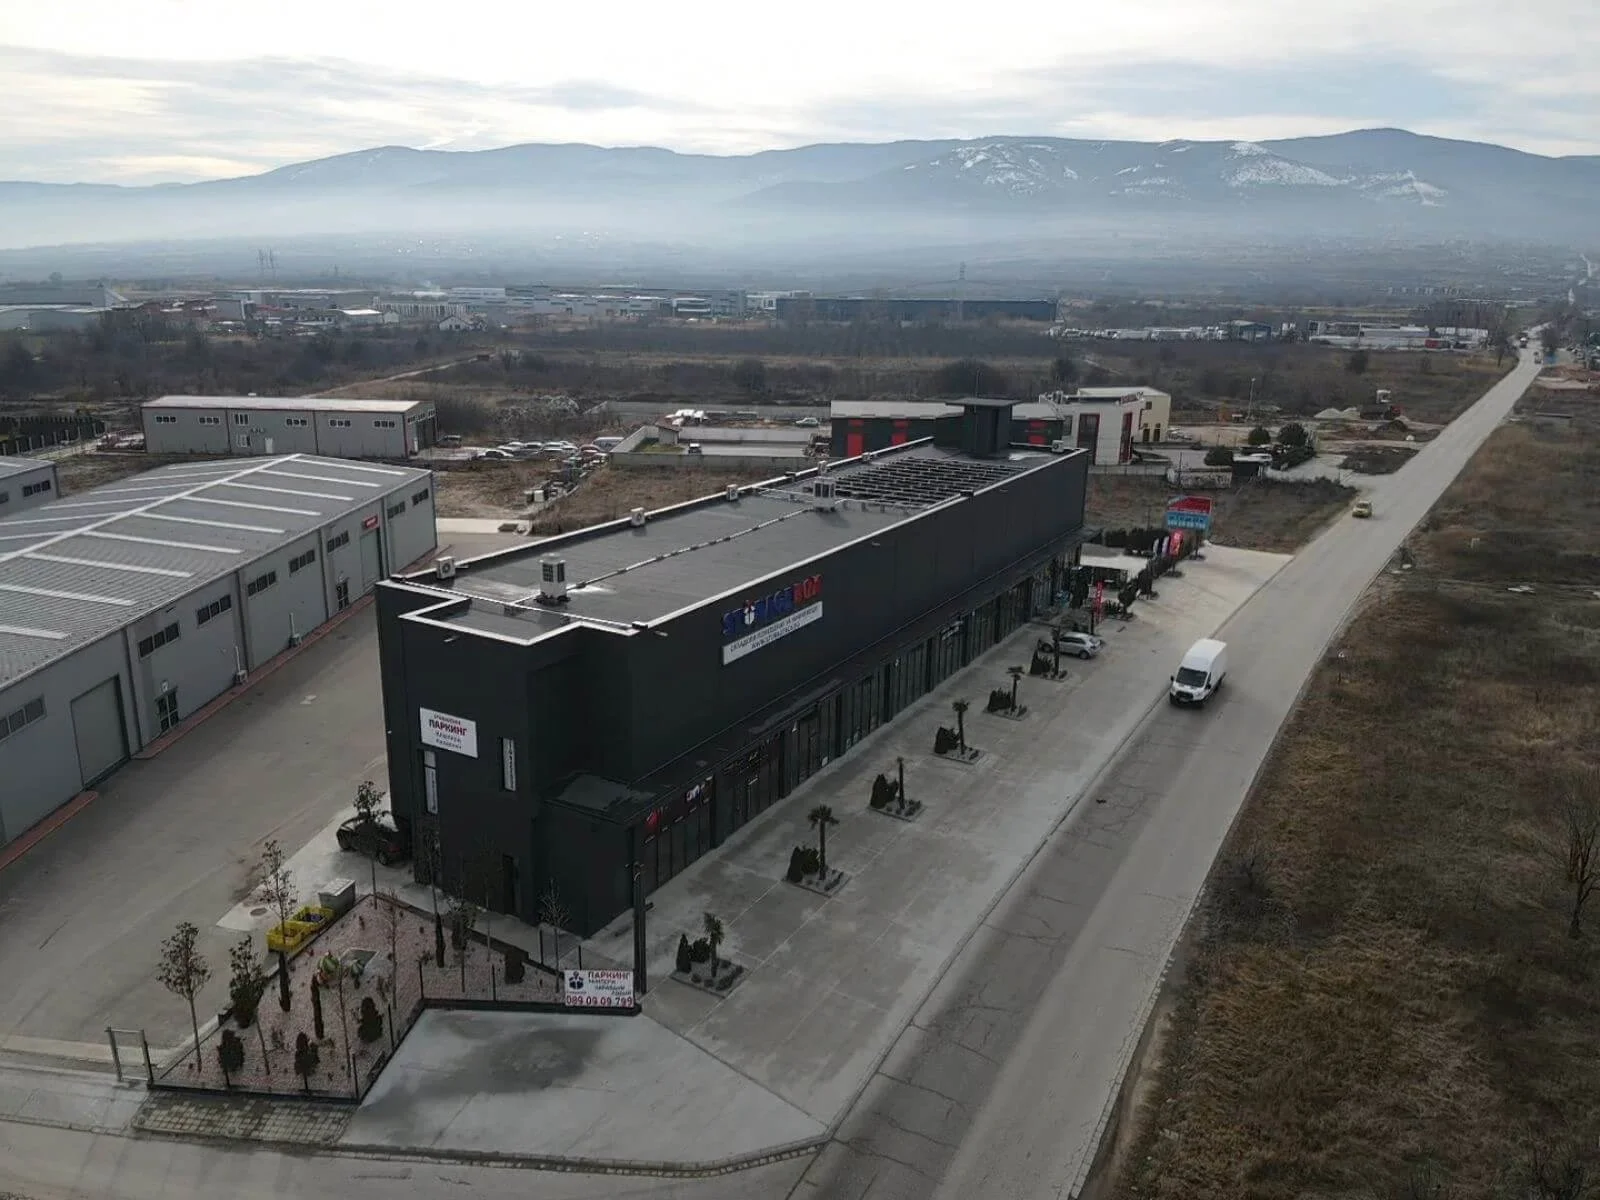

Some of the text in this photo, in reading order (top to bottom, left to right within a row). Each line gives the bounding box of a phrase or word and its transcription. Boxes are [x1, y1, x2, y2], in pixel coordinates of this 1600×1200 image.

[429, 719, 467, 736] ПАРКИНГ
[588, 971, 630, 980] ПАРКИНГ
[566, 995, 584, 1005] 089
[586, 996, 598, 1005] 09
[600, 996, 612, 1006] 09
